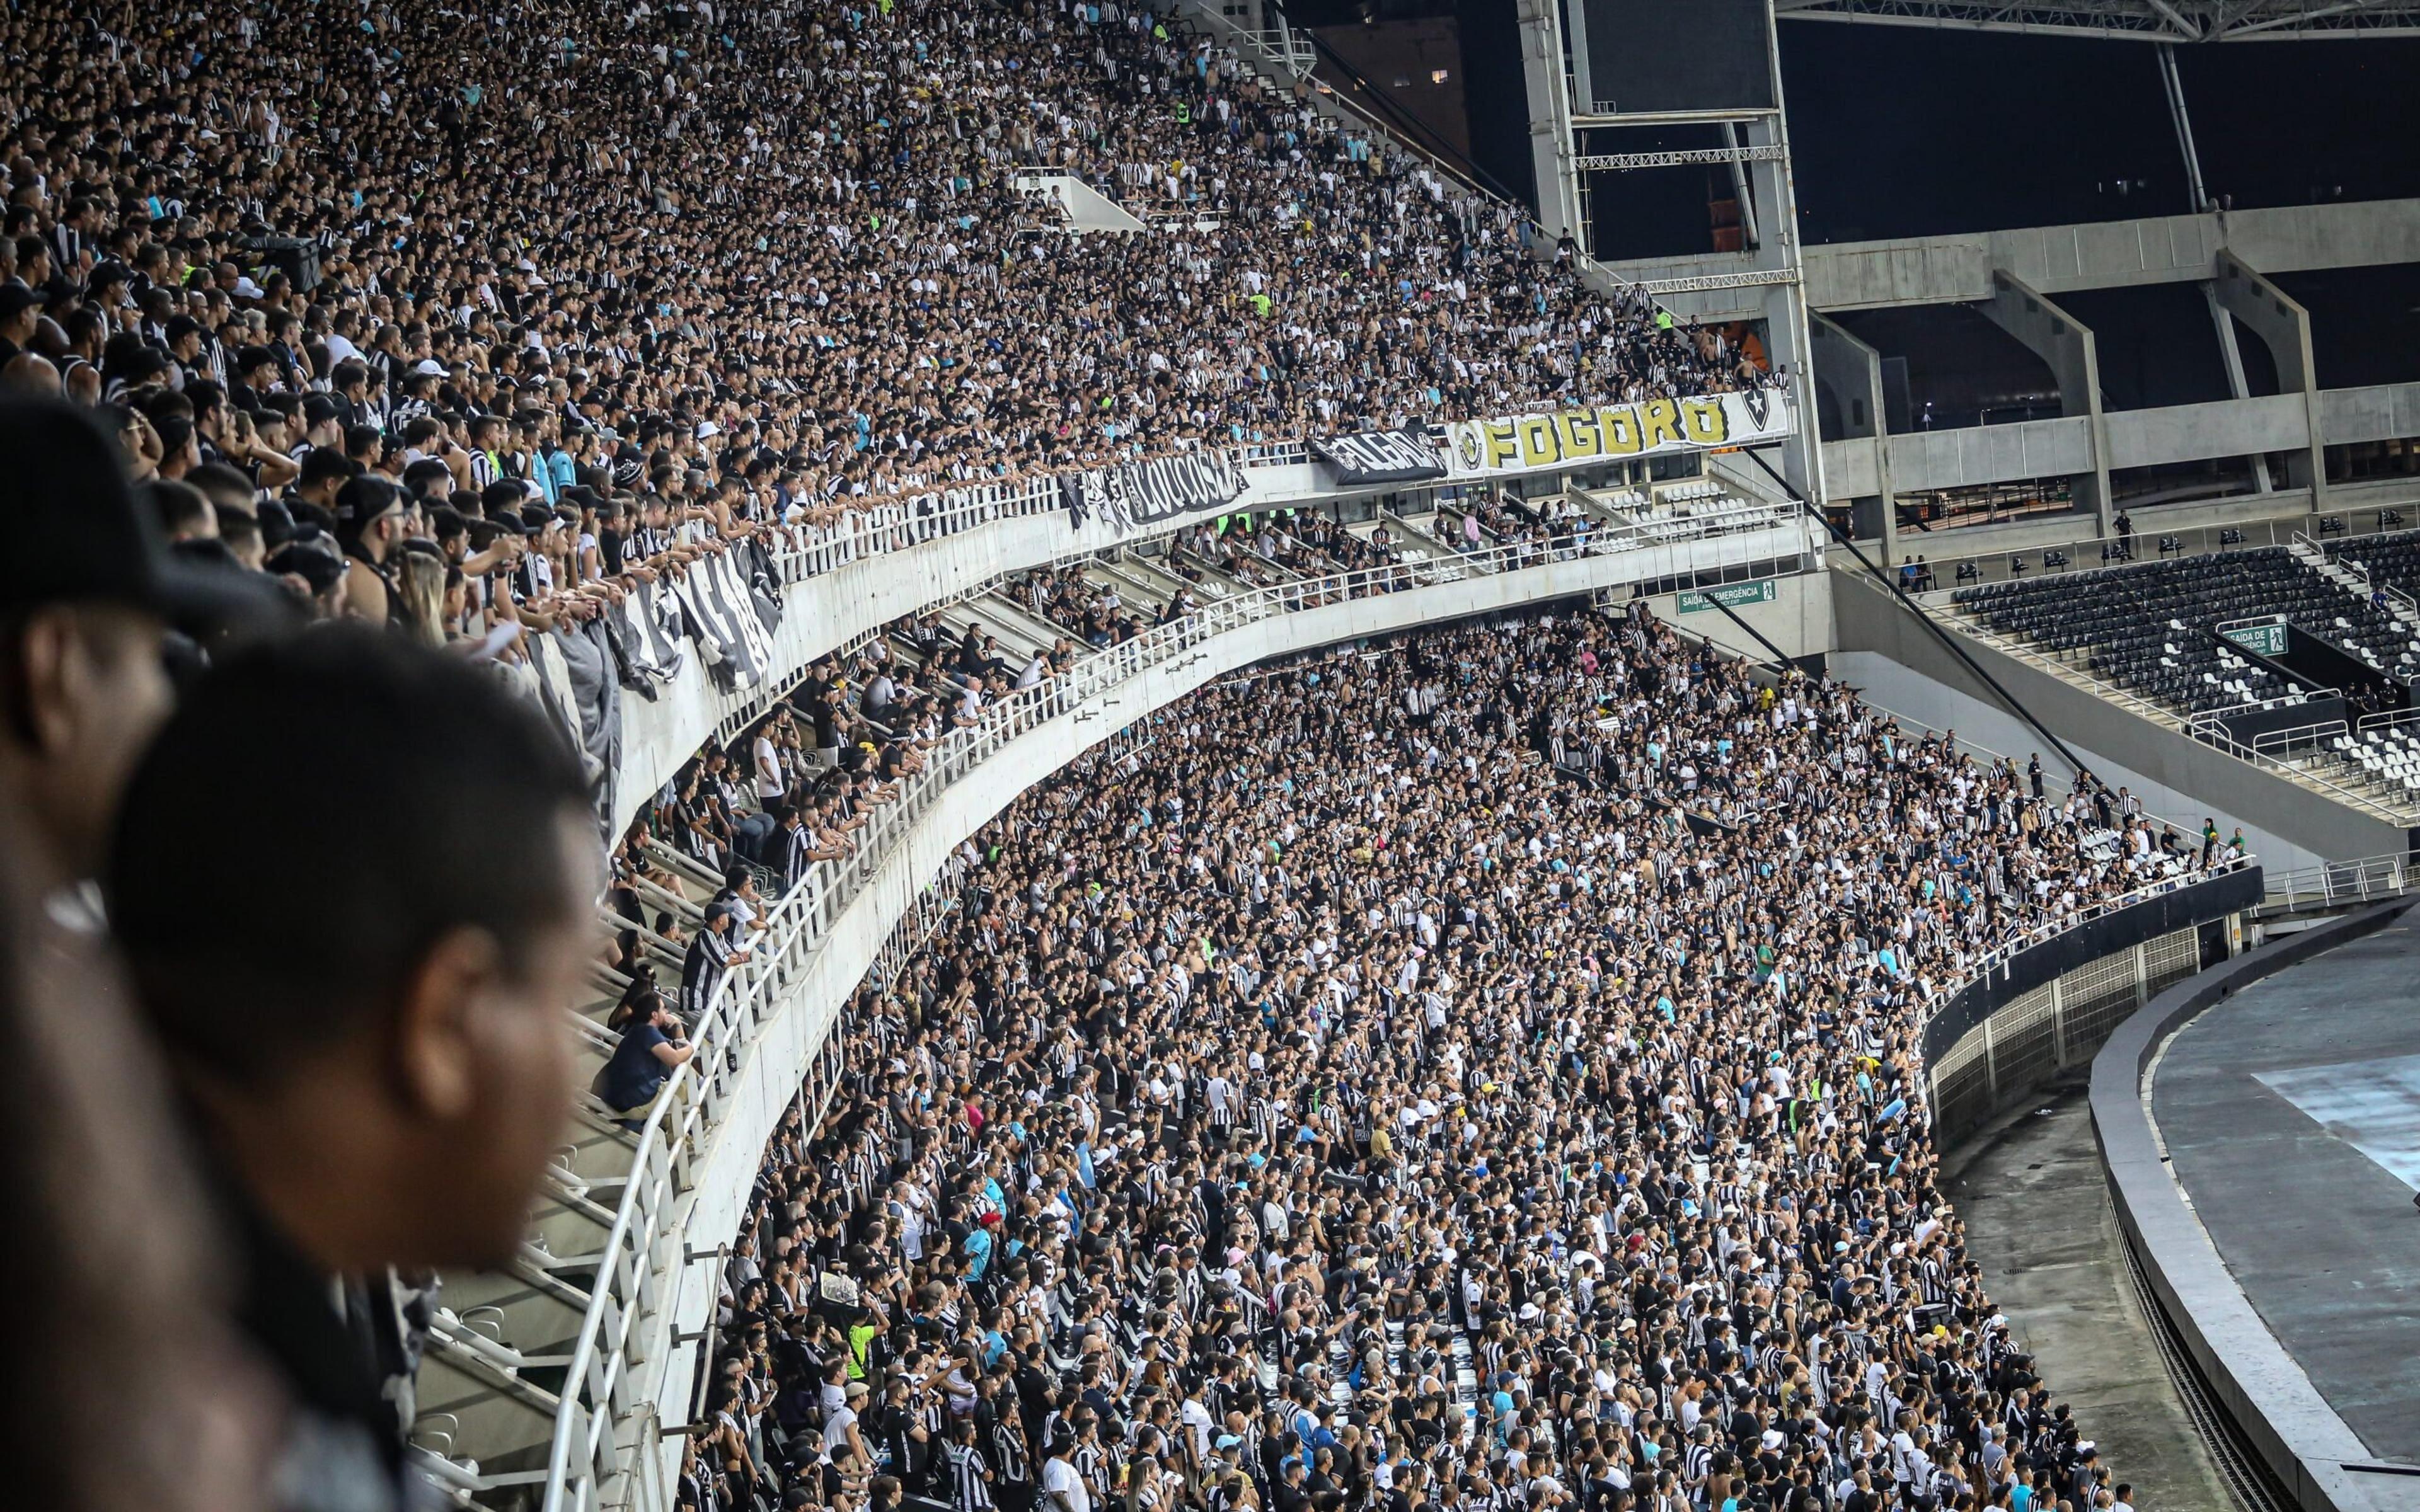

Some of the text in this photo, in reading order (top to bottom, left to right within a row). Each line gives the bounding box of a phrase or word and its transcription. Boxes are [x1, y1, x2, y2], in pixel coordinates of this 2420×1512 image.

[1131, 453, 1220, 516] LOUCOS
[1683, 594, 1703, 606] SAÍDA
[1714, 587, 1758, 601] EMERGÊNCIA
[2231, 631, 2266, 642] SAÍDA DE
